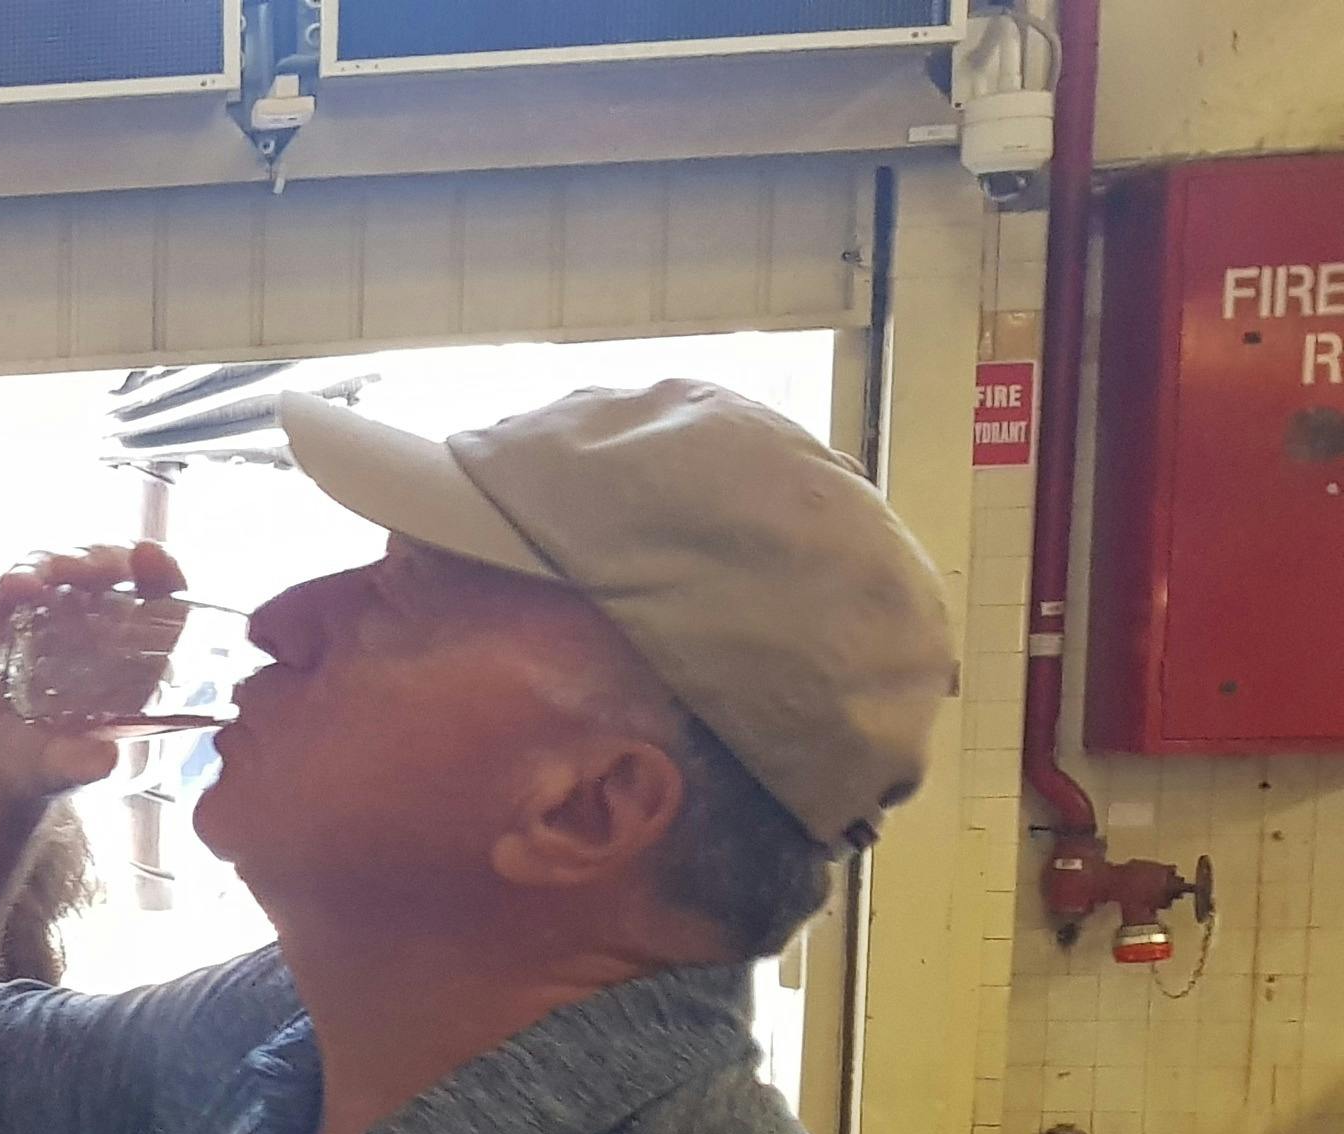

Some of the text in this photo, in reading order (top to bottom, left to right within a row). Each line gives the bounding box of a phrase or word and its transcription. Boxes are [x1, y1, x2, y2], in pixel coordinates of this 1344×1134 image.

[1223, 262, 1344, 320] FIRE
[975, 384, 1023, 408] FIRE
[973, 420, 1027, 445] YDRANT
